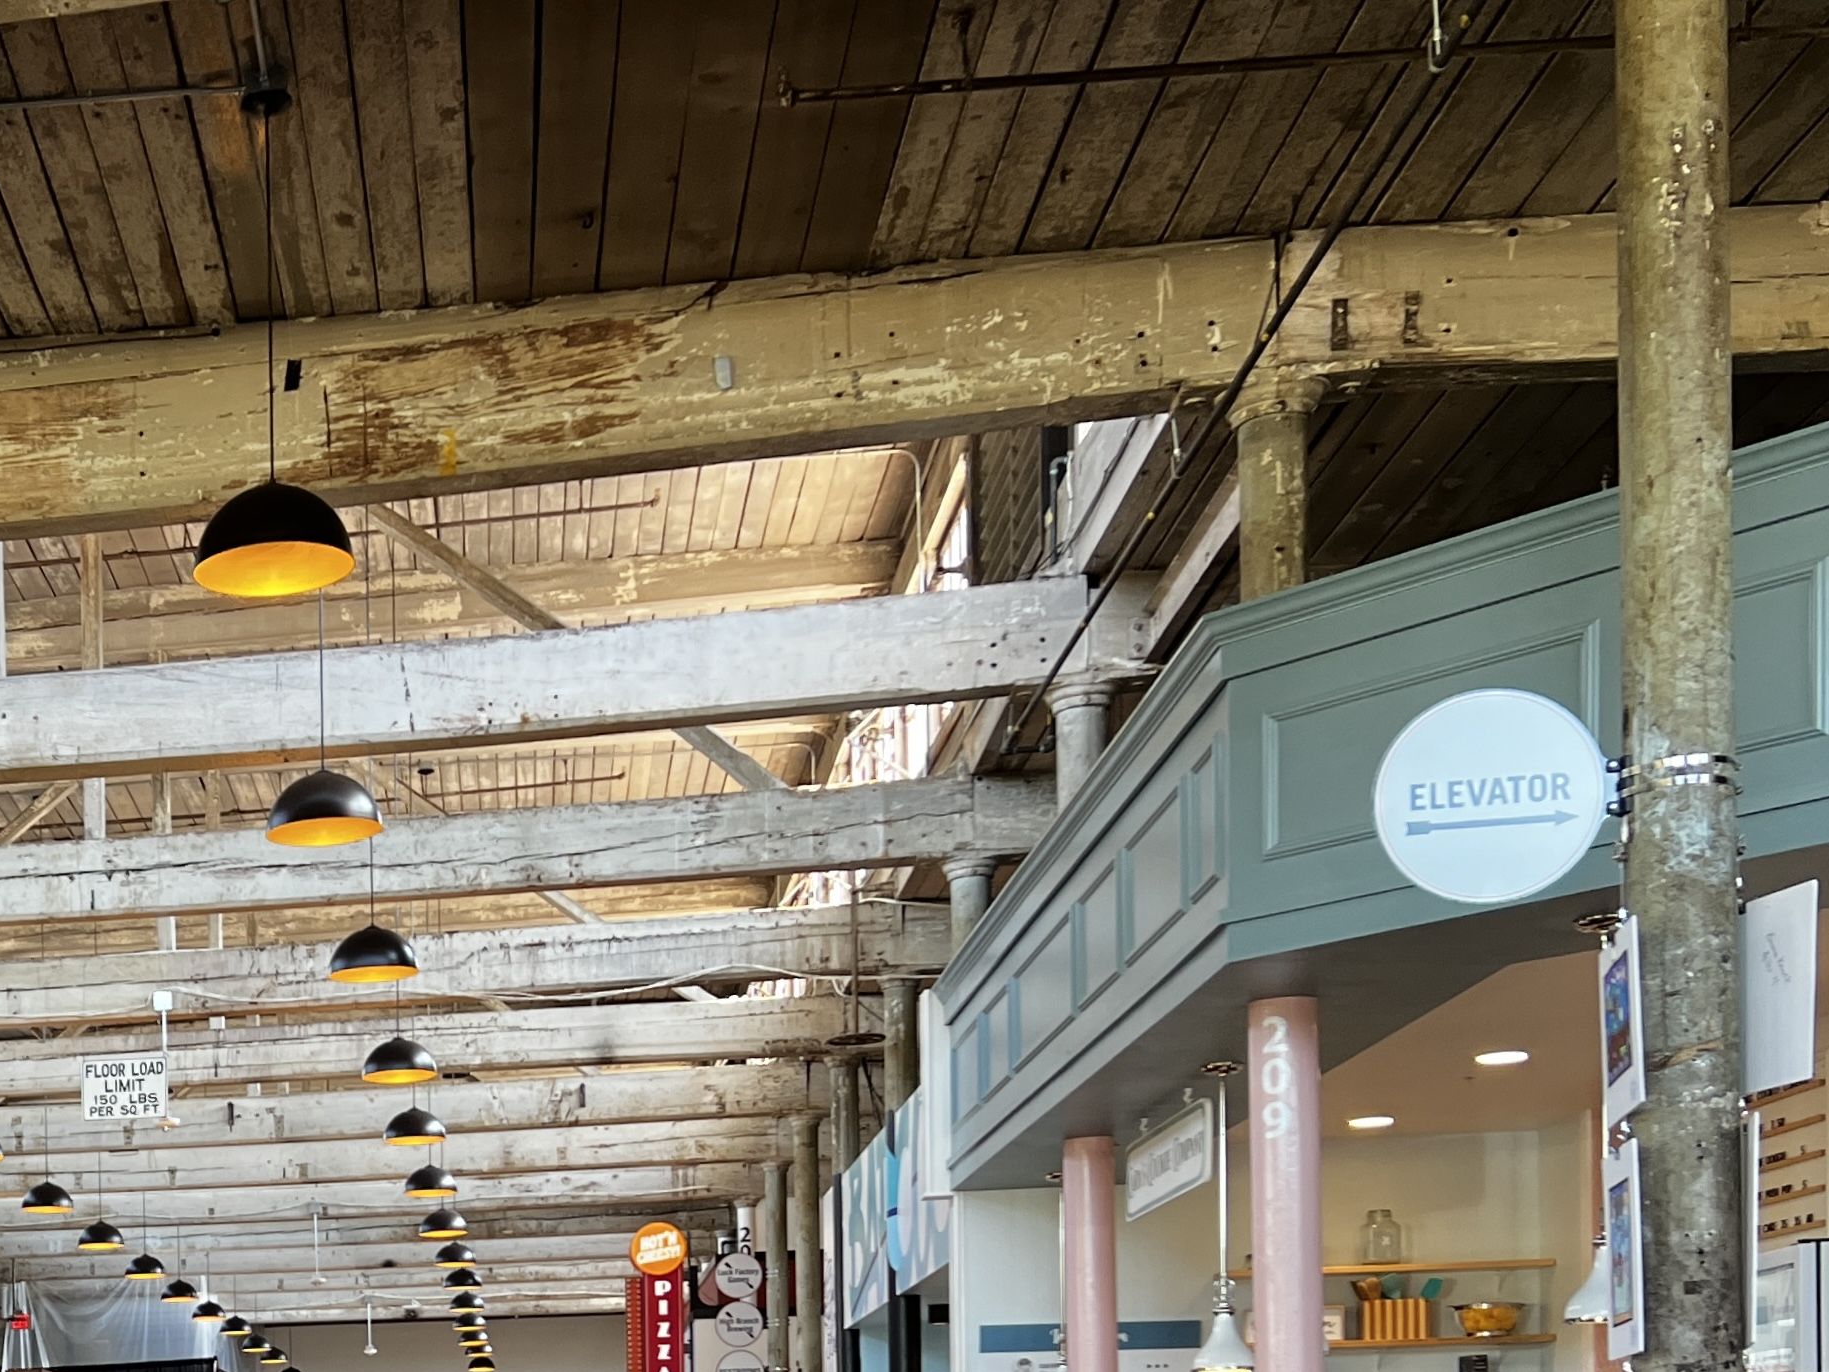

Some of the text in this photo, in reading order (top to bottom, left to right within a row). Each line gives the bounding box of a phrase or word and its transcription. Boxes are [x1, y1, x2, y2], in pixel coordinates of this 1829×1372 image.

[1409, 772, 1572, 811] ELEVATOR
[85, 1061, 164, 1078] FLOOR LOAD
[1261, 1015, 1291, 1139] 209
[104, 1079, 145, 1093] LIMIT
[94, 1093, 158, 1105] 150 LBS
[89, 1104, 160, 1117] PER SQ FT
[740, 1227, 751, 1255] 20
